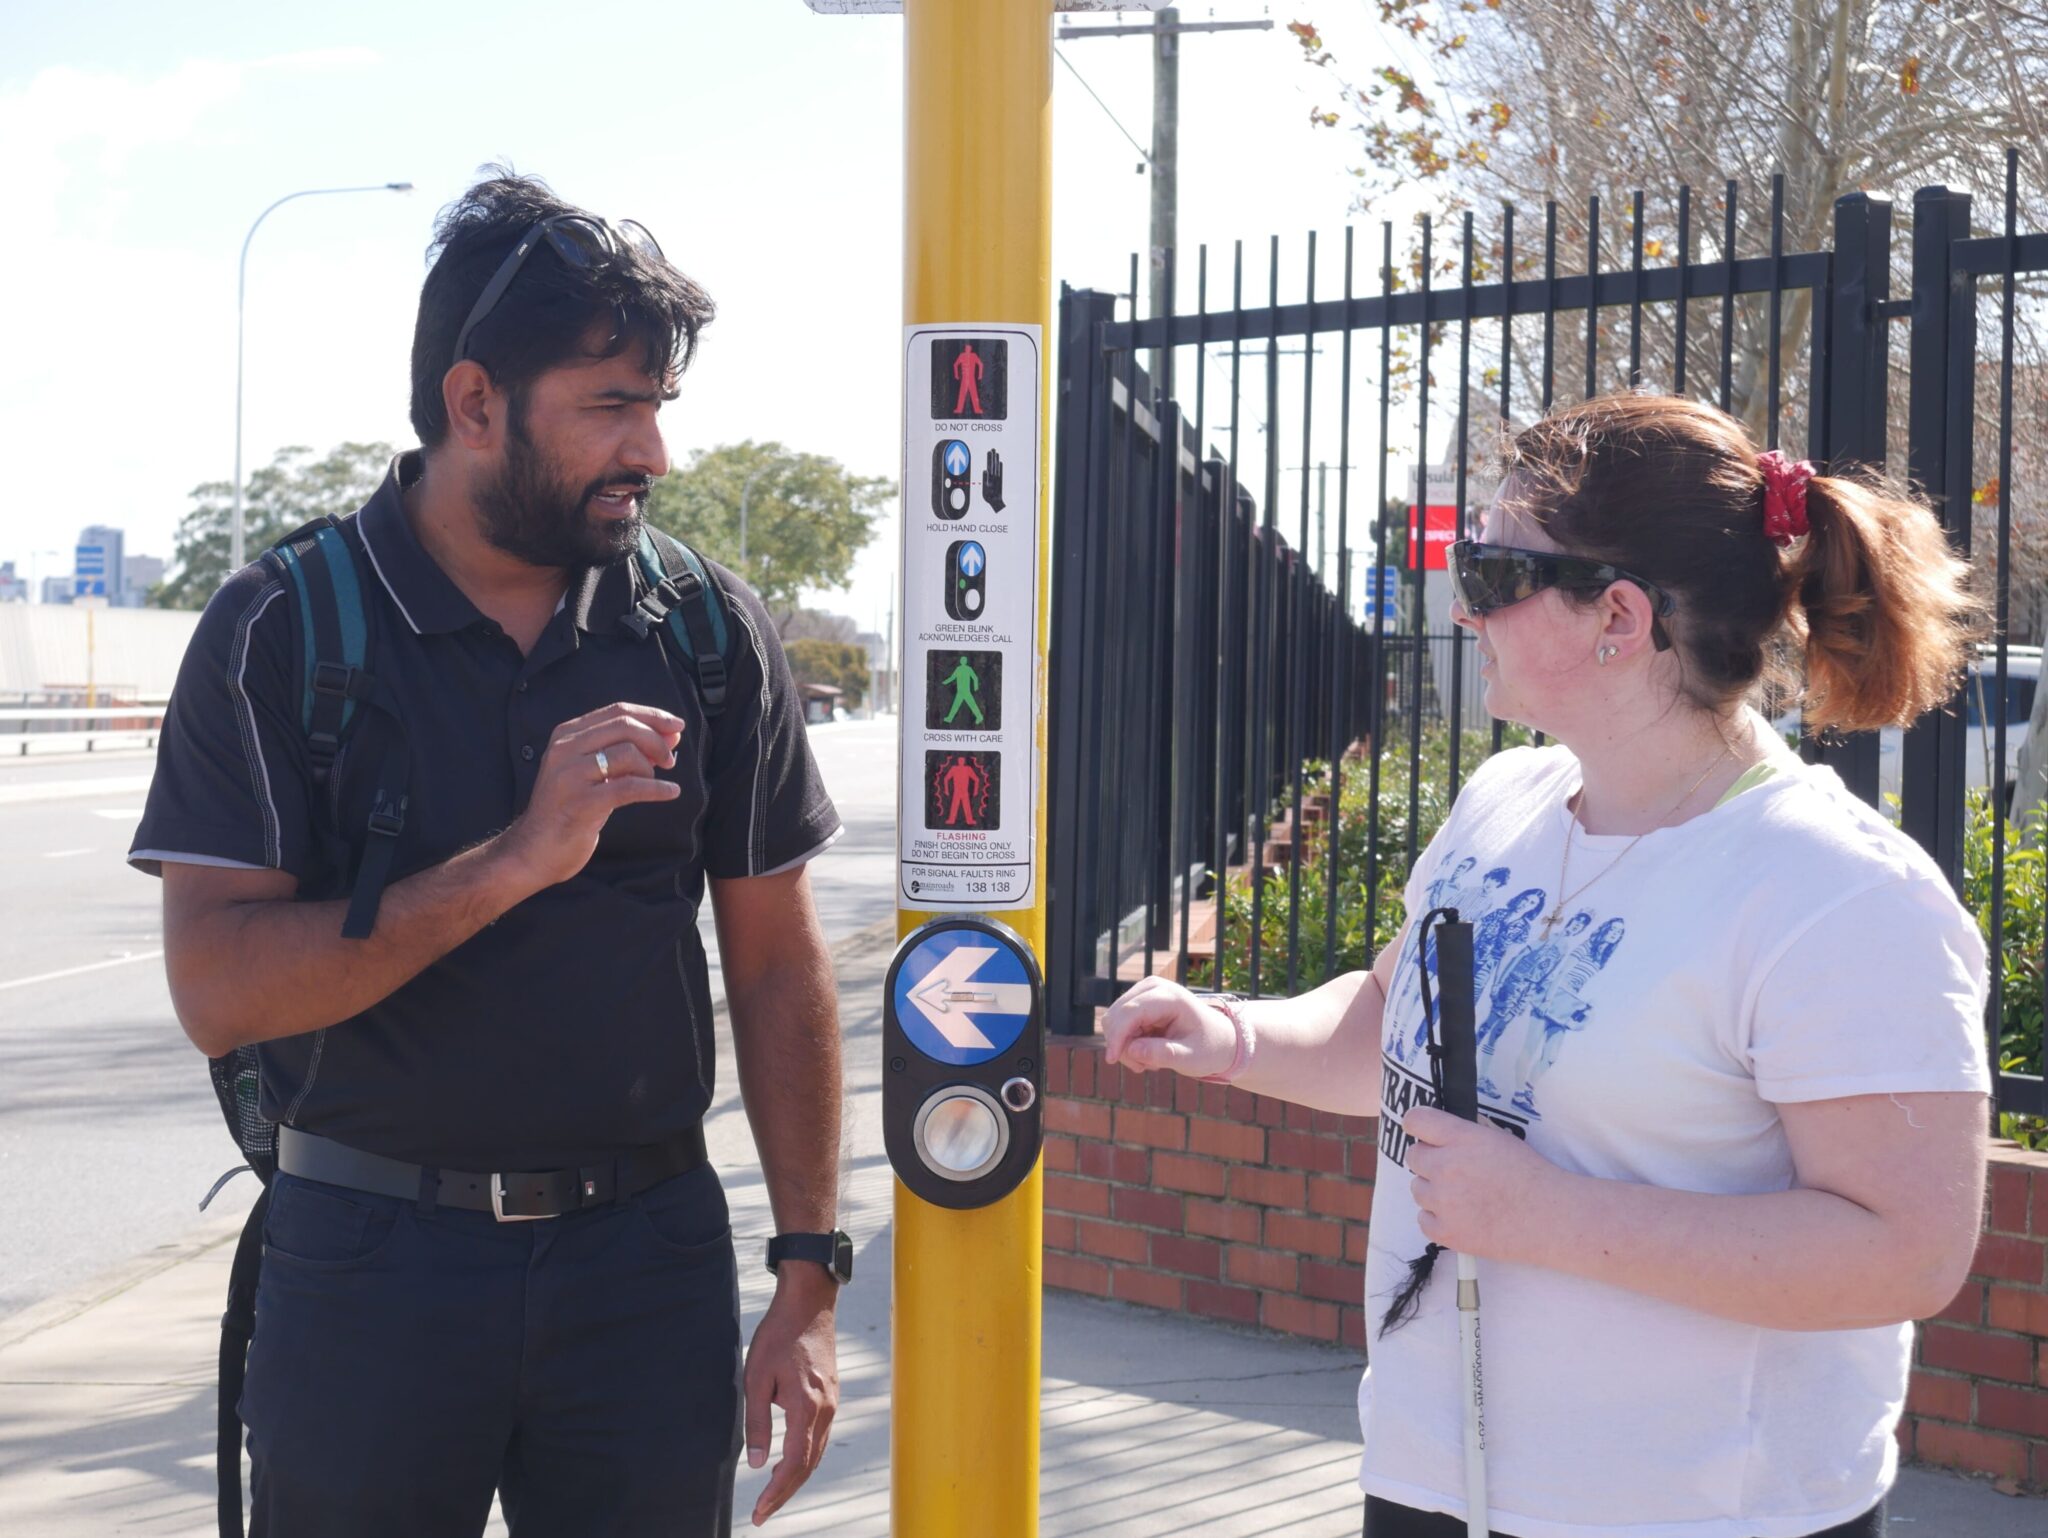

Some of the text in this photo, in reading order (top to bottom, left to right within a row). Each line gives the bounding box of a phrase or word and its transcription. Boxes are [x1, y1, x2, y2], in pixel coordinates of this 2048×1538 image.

[971, 424, 1002, 432] CROSS
[927, 524, 1008, 533] HOLD HAND CLOSE
[935, 624, 965, 632] GREEN
[919, 633, 1012, 643] ACKNOWLEDGES CALL
[924, 734, 952, 742] CROSS
[954, 734, 977, 742] WITH
[937, 833, 986, 841] FLASHING
[915, 841, 1011, 850] FINISH CROSSING ONLY
[923, 850, 939, 858] NOT
[942, 851, 969, 859] BEGIN
[985, 852, 1015, 860] CROSS
[912, 868, 1015, 878] FOR SIGNAL FAULTS RING
[966, 883, 1010, 892] 138 138
